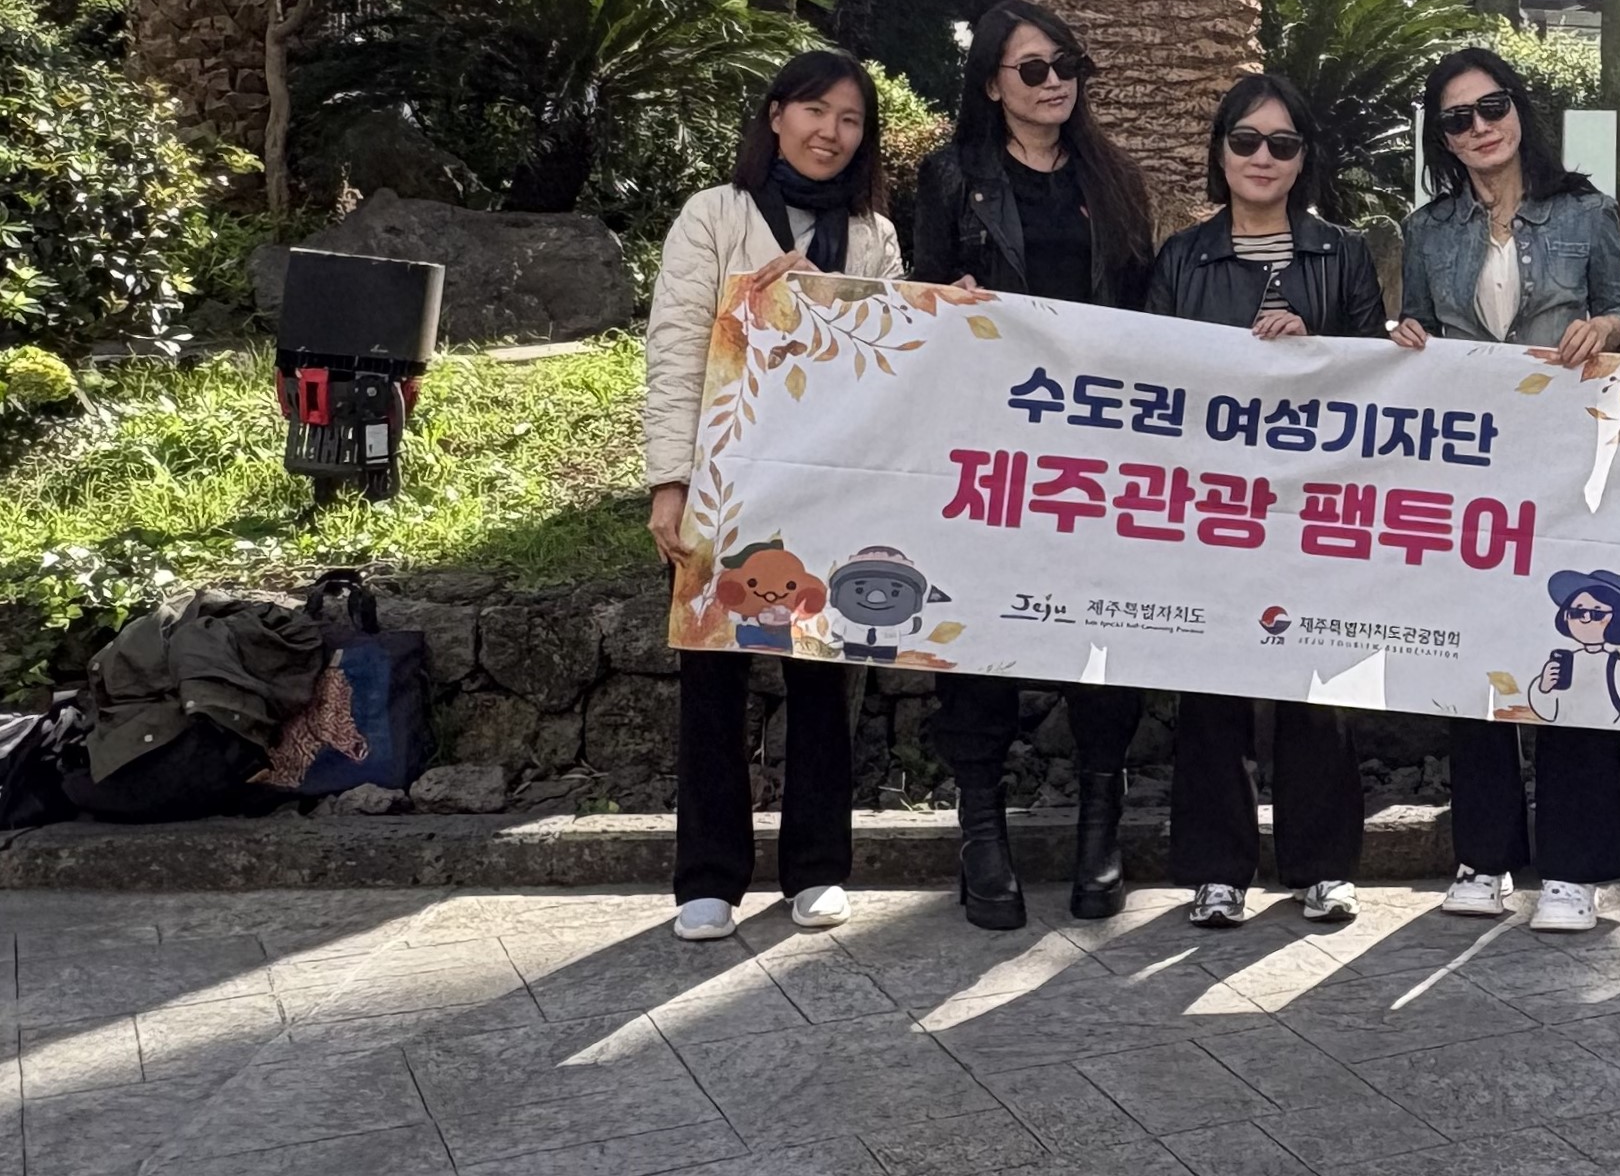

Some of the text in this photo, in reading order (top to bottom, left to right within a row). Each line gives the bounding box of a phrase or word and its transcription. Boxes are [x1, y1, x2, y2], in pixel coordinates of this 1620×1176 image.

[1007, 366, 1499, 467] 수도권 여성기자단
[941, 448, 1537, 576] 제주관광 팸투어
[1010, 593, 1067, 622] Jeju
